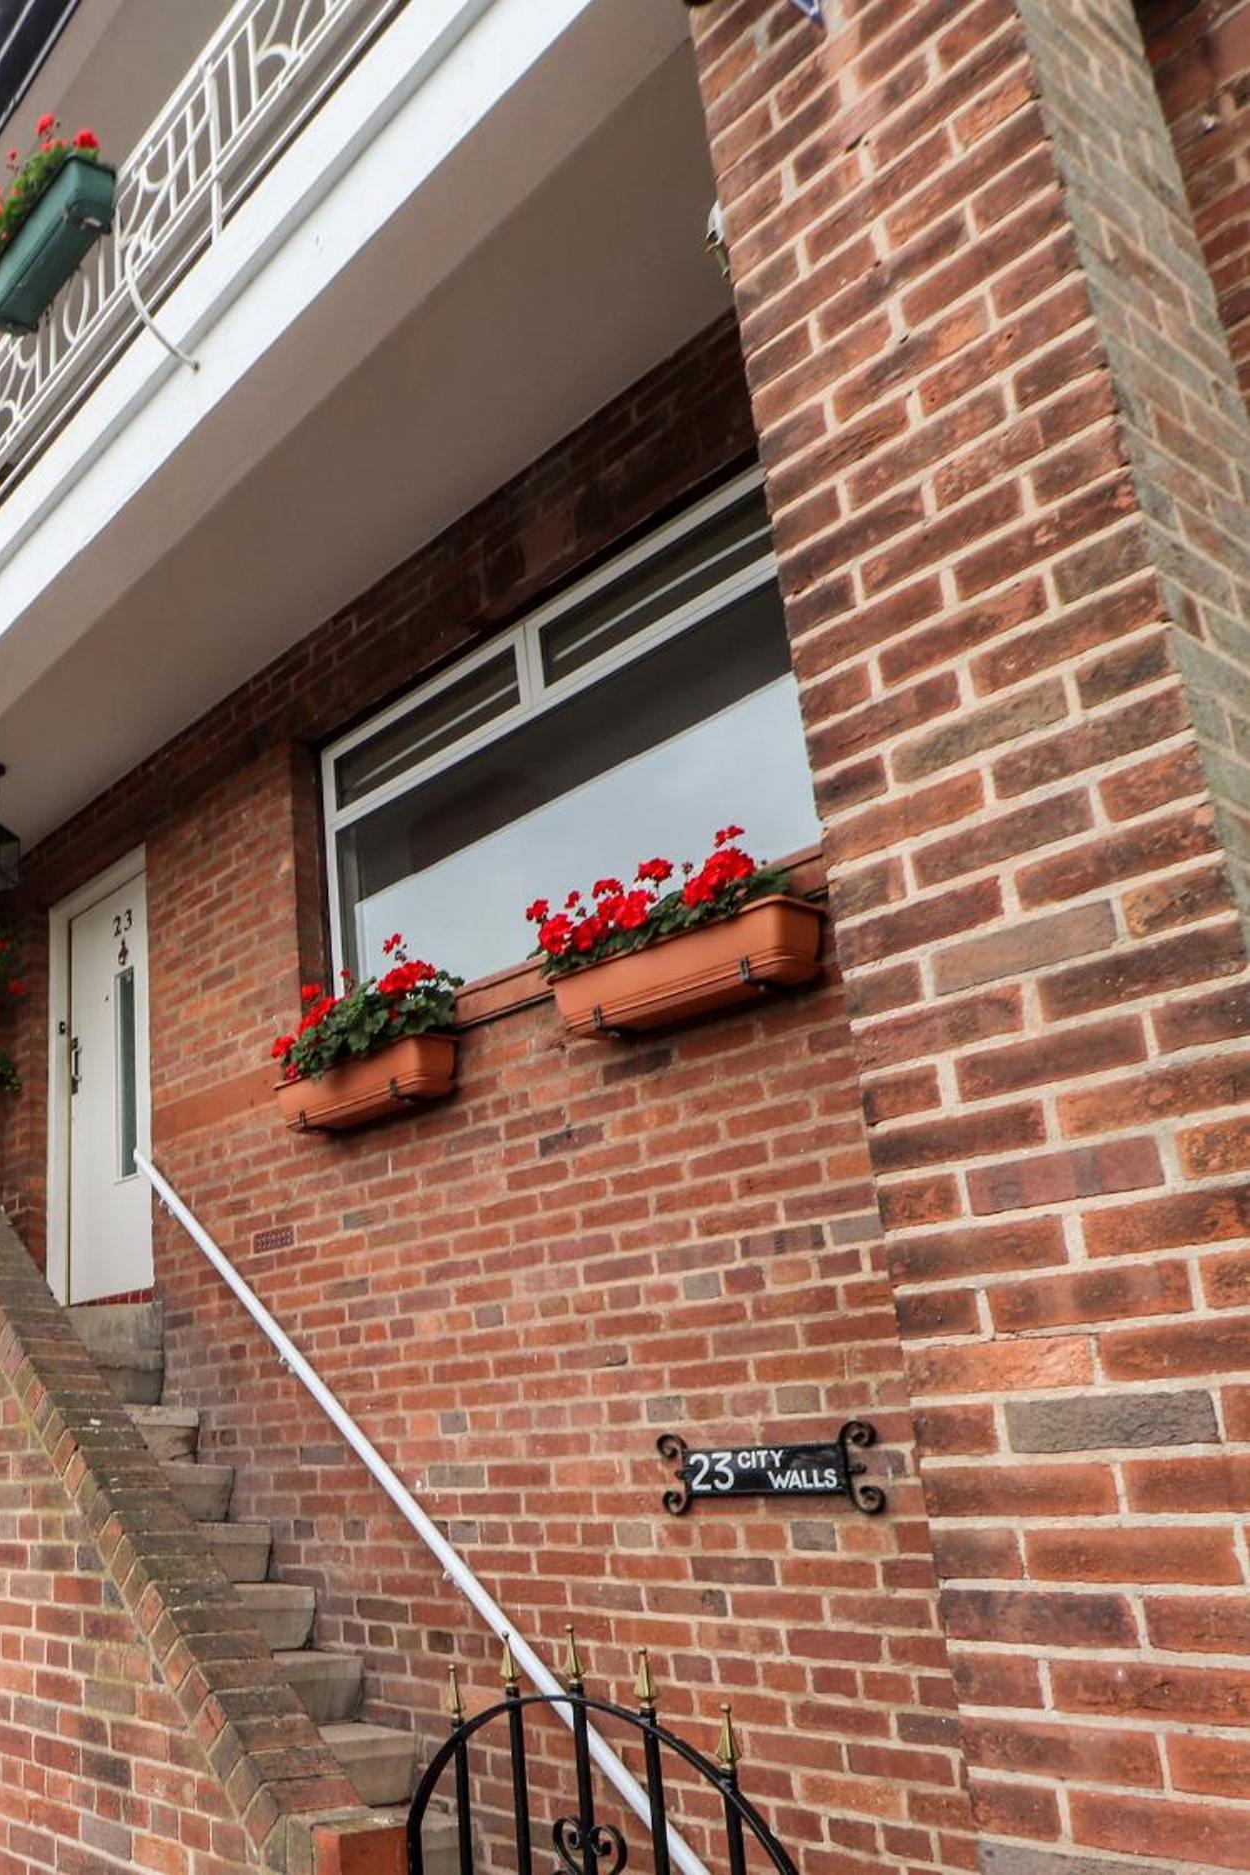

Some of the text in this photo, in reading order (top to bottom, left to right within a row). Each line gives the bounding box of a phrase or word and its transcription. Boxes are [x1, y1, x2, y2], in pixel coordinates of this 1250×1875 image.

[113, 908, 132, 937] 23
[689, 1450, 784, 1490] 23 CITY
[767, 1468, 837, 1489] WALLS
